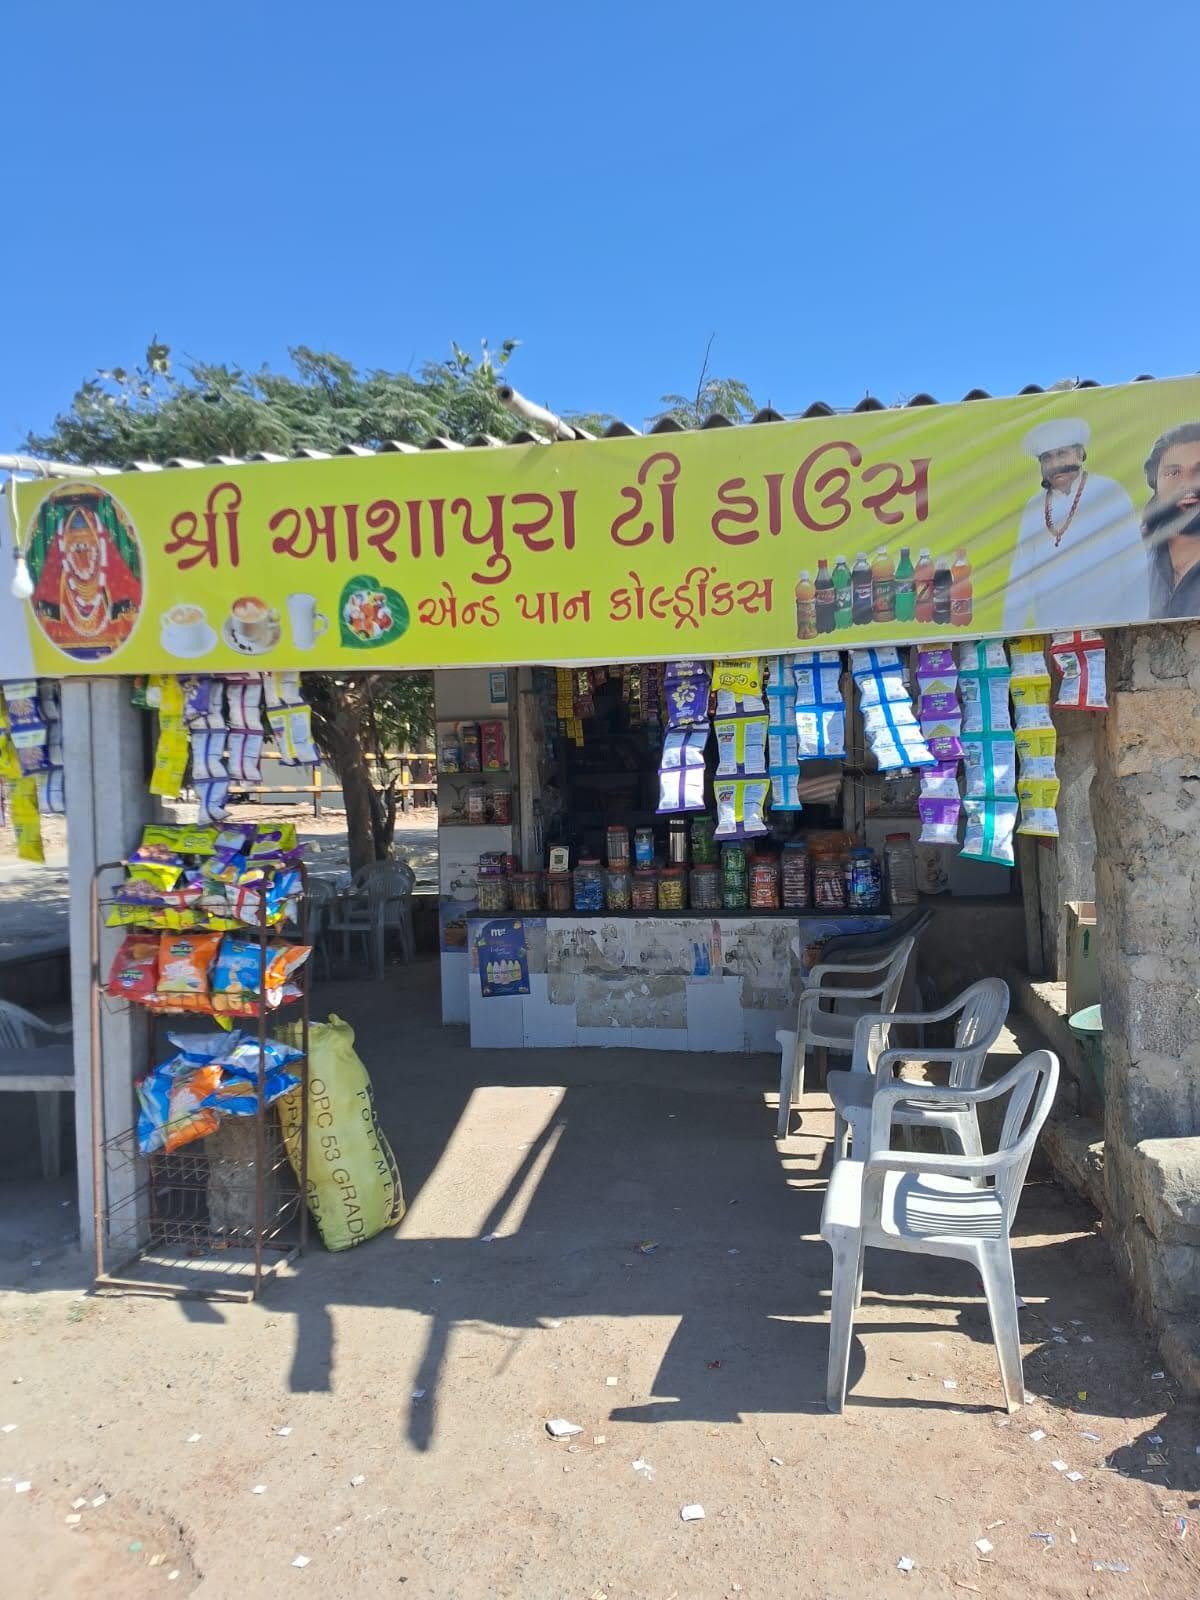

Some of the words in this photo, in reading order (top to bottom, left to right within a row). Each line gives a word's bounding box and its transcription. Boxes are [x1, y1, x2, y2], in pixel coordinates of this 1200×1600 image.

[163, 480, 242, 571] શ્રી
[268, 488, 577, 585] આશાપુરા
[610, 451, 681, 548] ટી
[711, 440, 932, 546] હાઉસ
[417, 579, 501, 629] એન્ડ
[515, 589, 591, 625] પાન
[309, 1078, 333, 1129] OPC
[320, 1135, 342, 1162] 53
[332, 1168, 367, 1246] GRADE
